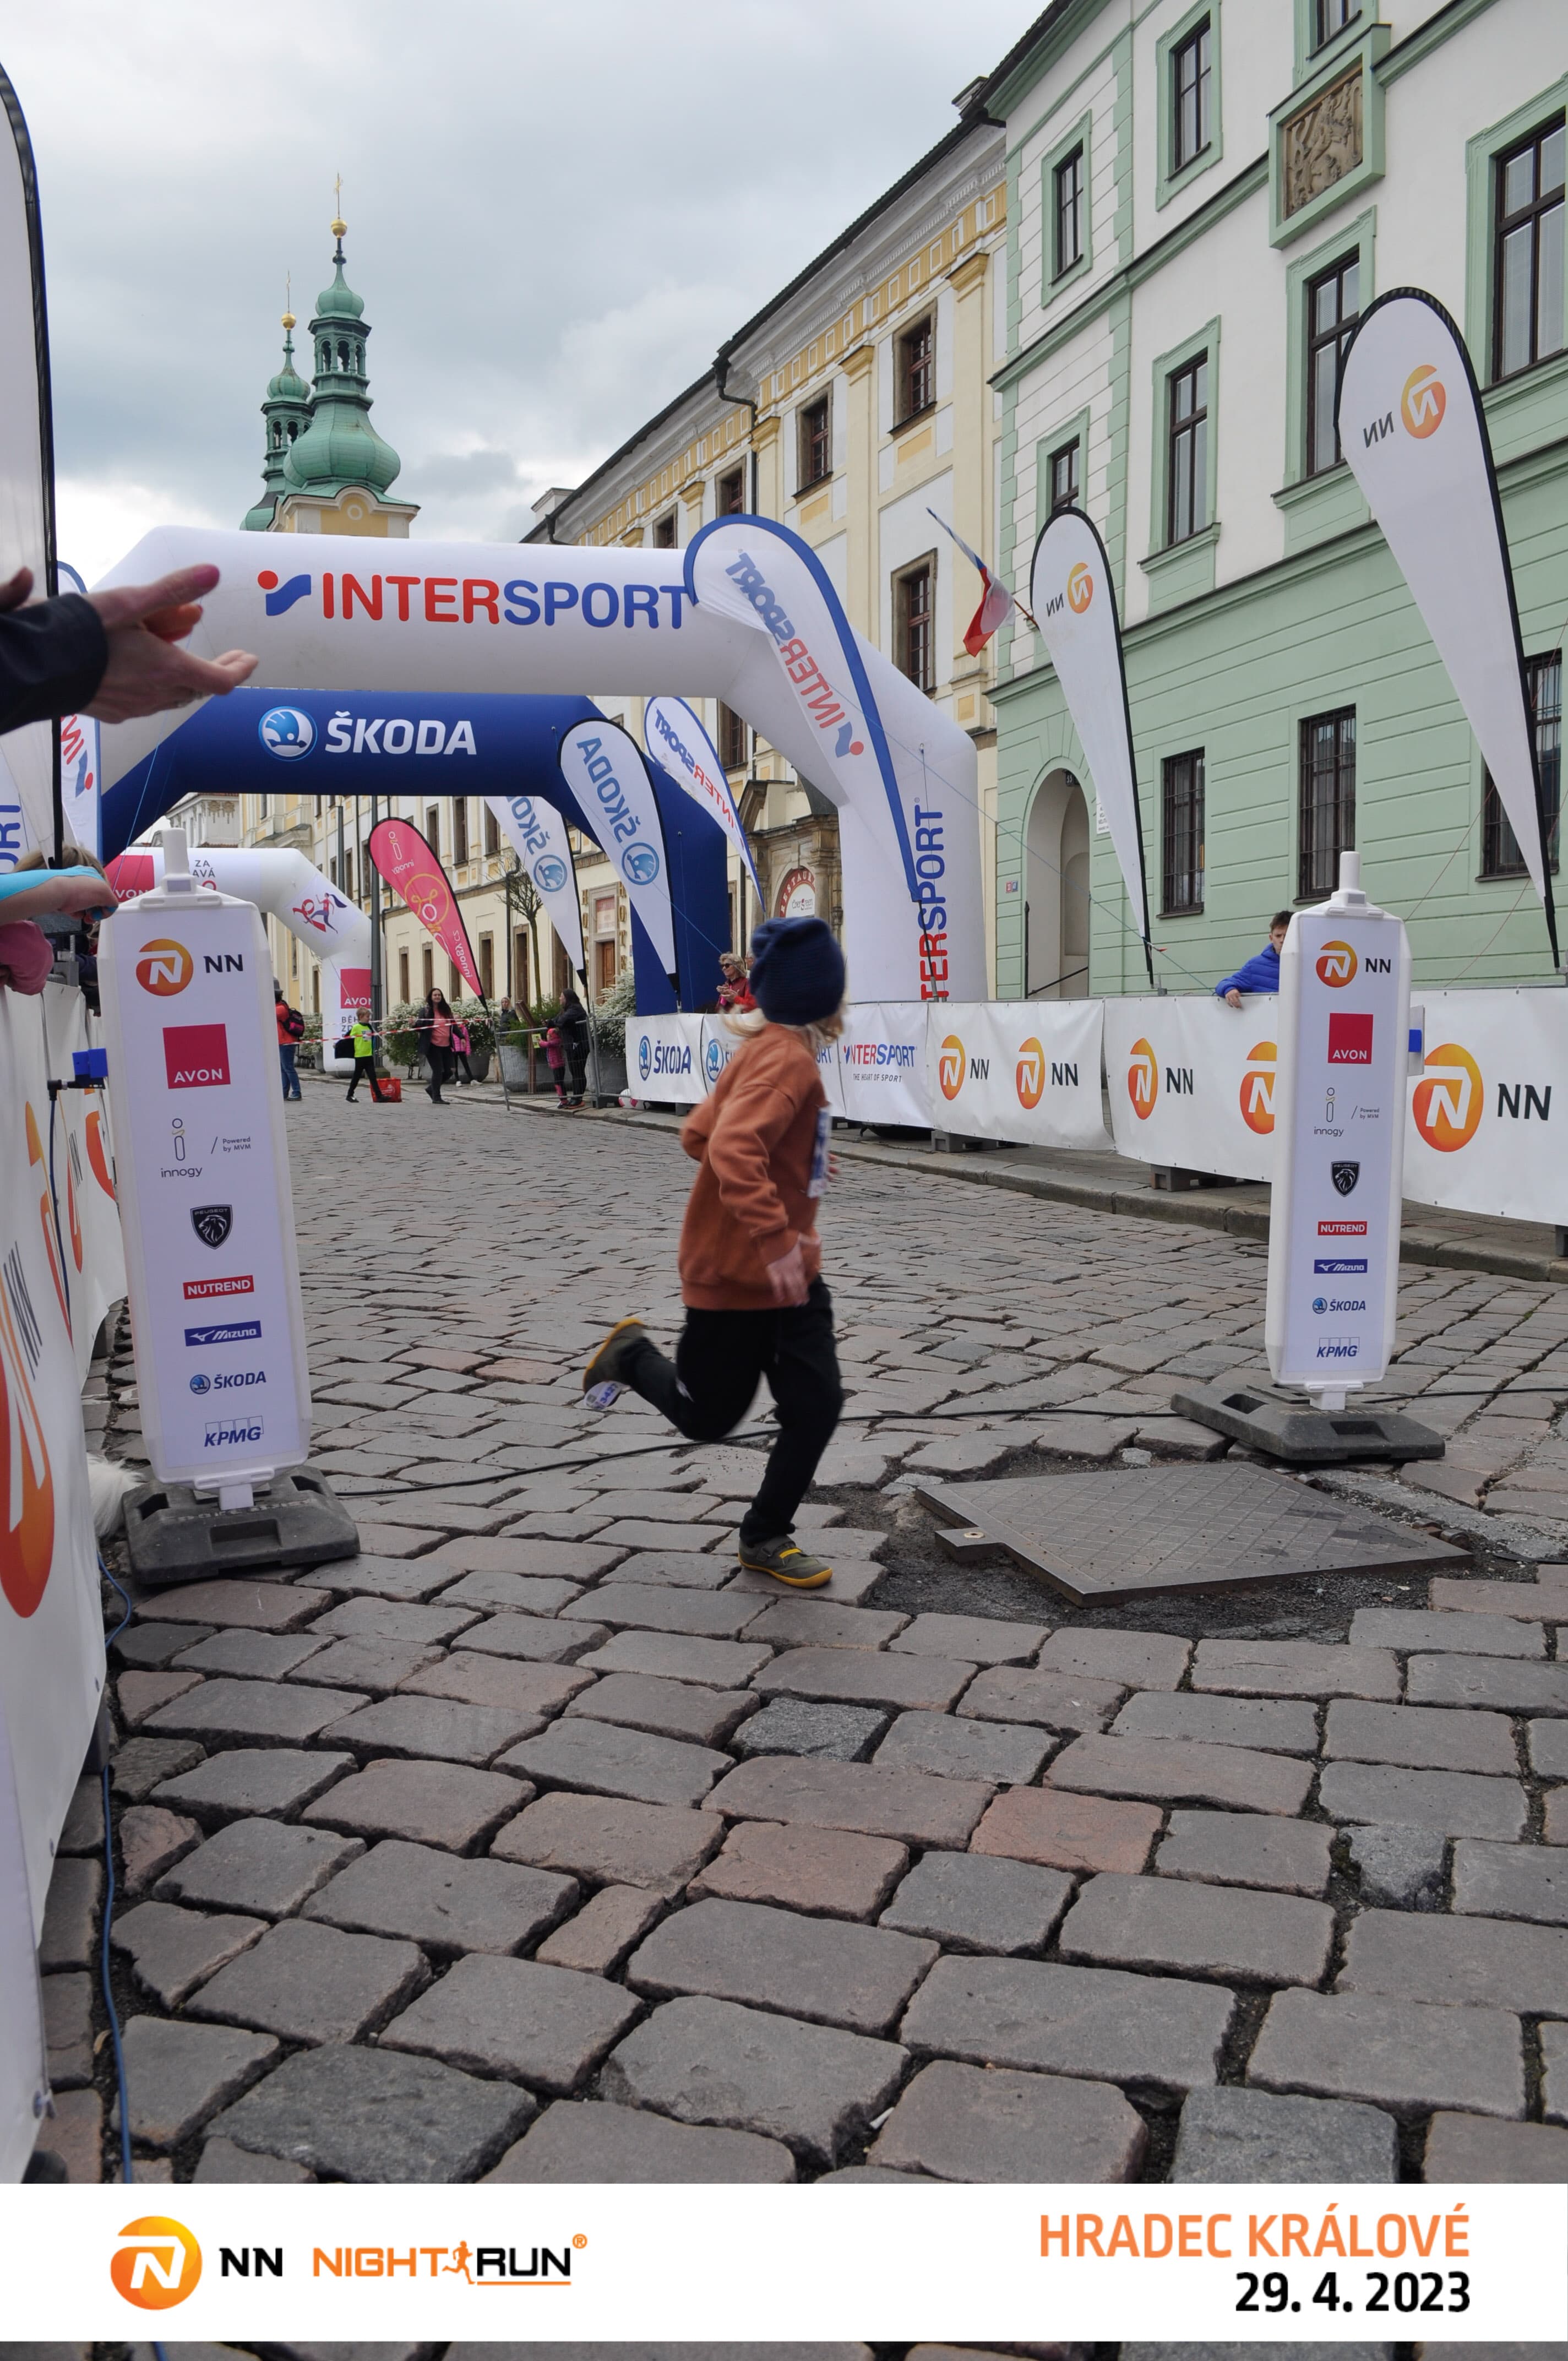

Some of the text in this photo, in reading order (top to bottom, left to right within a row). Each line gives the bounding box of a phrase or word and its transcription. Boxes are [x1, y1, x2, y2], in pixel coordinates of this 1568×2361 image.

[323, 573, 687, 629] INTERSPORT
[325, 710, 477, 755] ŠKODA
[781, 871, 815, 914] RESTAUR
[203, 954, 243, 973] NN
[1365, 958, 1391, 973] NN
[654, 1040, 692, 1074] ŠKODA
[1332, 1049, 1367, 1060] AVON
[174, 1068, 222, 1083] AVON
[881, 1074, 902, 1082] SPORT
[970, 1058, 989, 1080] NN
[1052, 1063, 1079, 1086] NN
[1166, 1068, 1193, 1095] NN
[1498, 1084, 1551, 1120] NN
[1314, 1127, 1344, 1136] innogy
[161, 1167, 203, 1178] innogy
[1321, 1224, 1365, 1233] NUTREND
[187, 1279, 251, 1296] NUTREND
[1329, 1299, 1366, 1312] ŠKODA
[1316, 1345, 1358, 1358] KPMG
[214, 1371, 266, 1390] ŠKODA
[204, 1426, 262, 1447] KPMG
